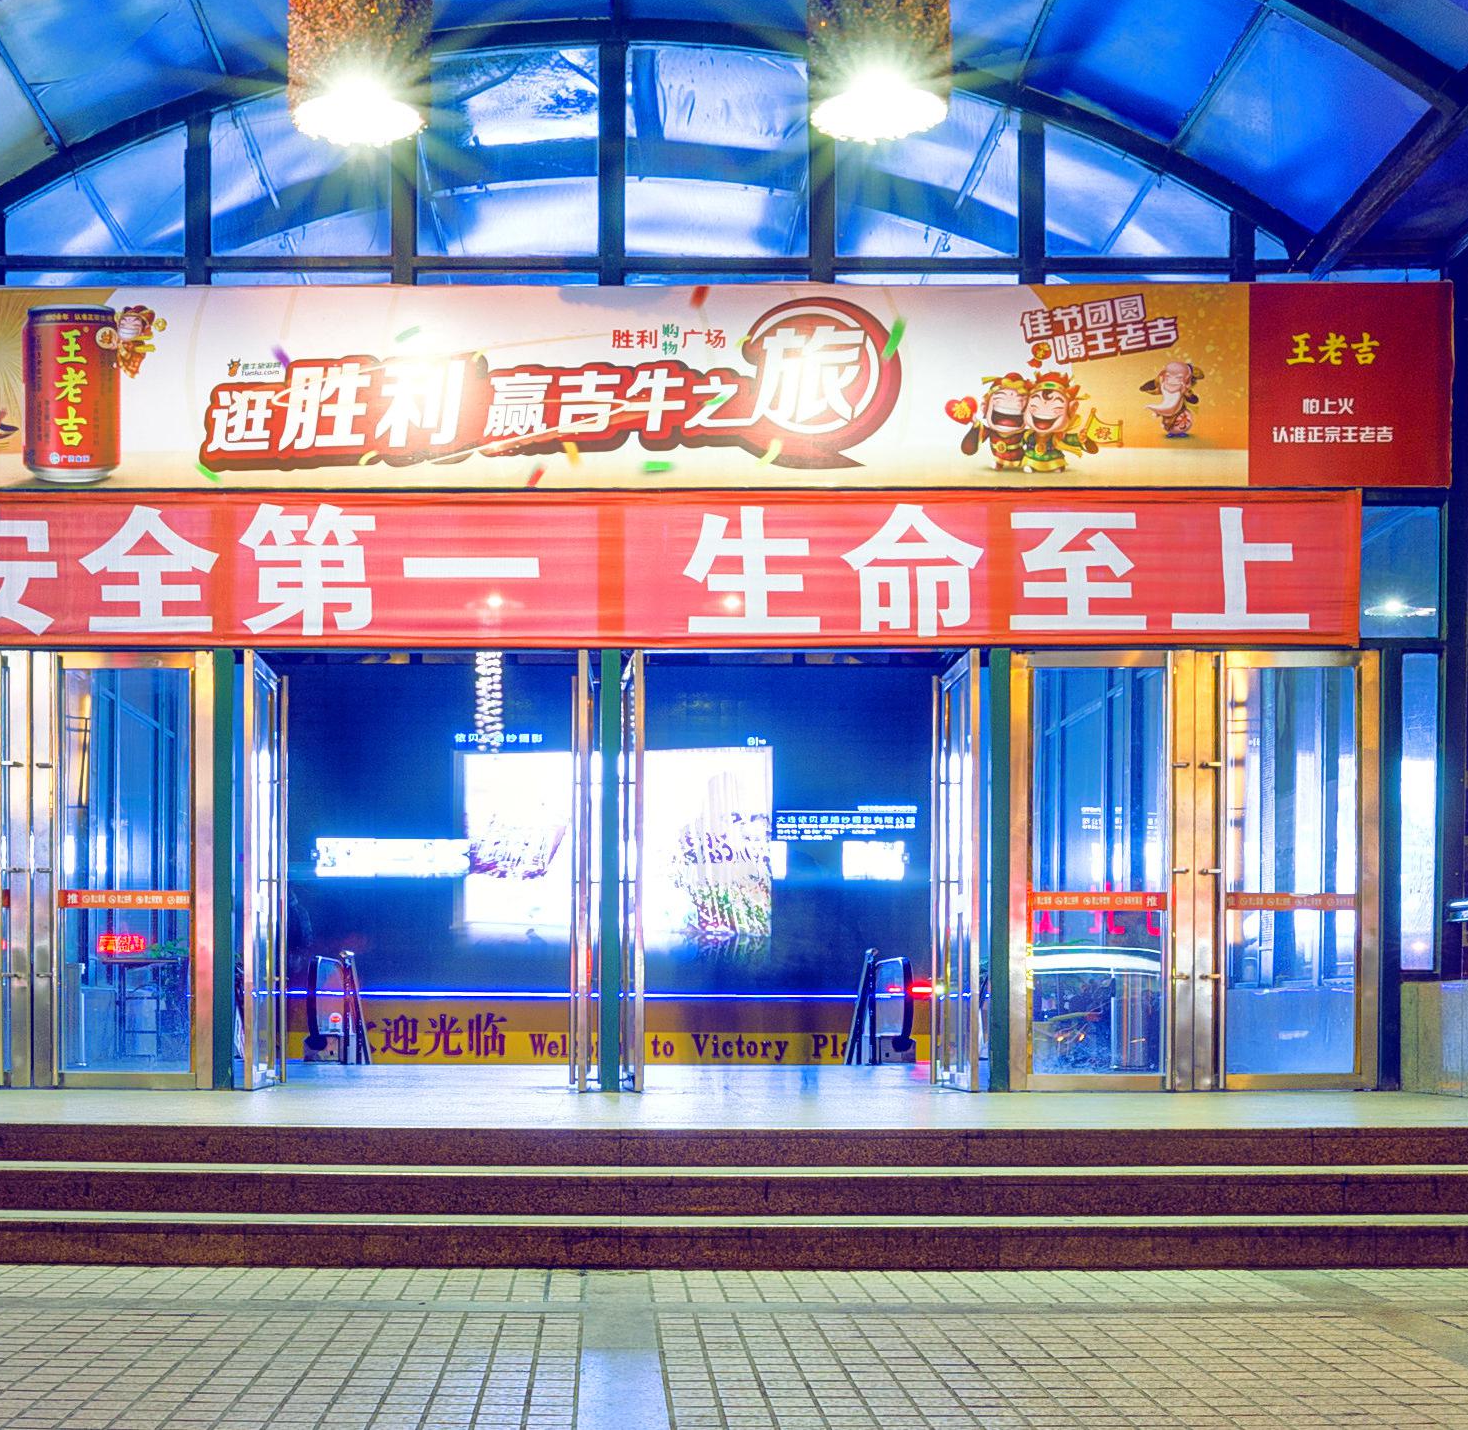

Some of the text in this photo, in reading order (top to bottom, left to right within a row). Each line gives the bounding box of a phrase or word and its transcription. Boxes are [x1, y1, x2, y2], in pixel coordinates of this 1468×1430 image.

[1021, 295, 1146, 340] 佳节团圆
[612, 322, 727, 355] 胜利购物广场
[1055, 317, 1178, 362] 喝王老吉
[1285, 332, 1380, 365] 王老吉
[54, 328, 89, 447] 王老吉
[1302, 397, 1355, 415] 怕上火
[1272, 426, 1394, 443] 认准正宗王老吉
[682, 502, 1311, 639] 生命至上
[366, 1012, 508, 1058] 迎光临
[650, 1033, 674, 1059] to
[691, 1032, 789, 1061] Victory
